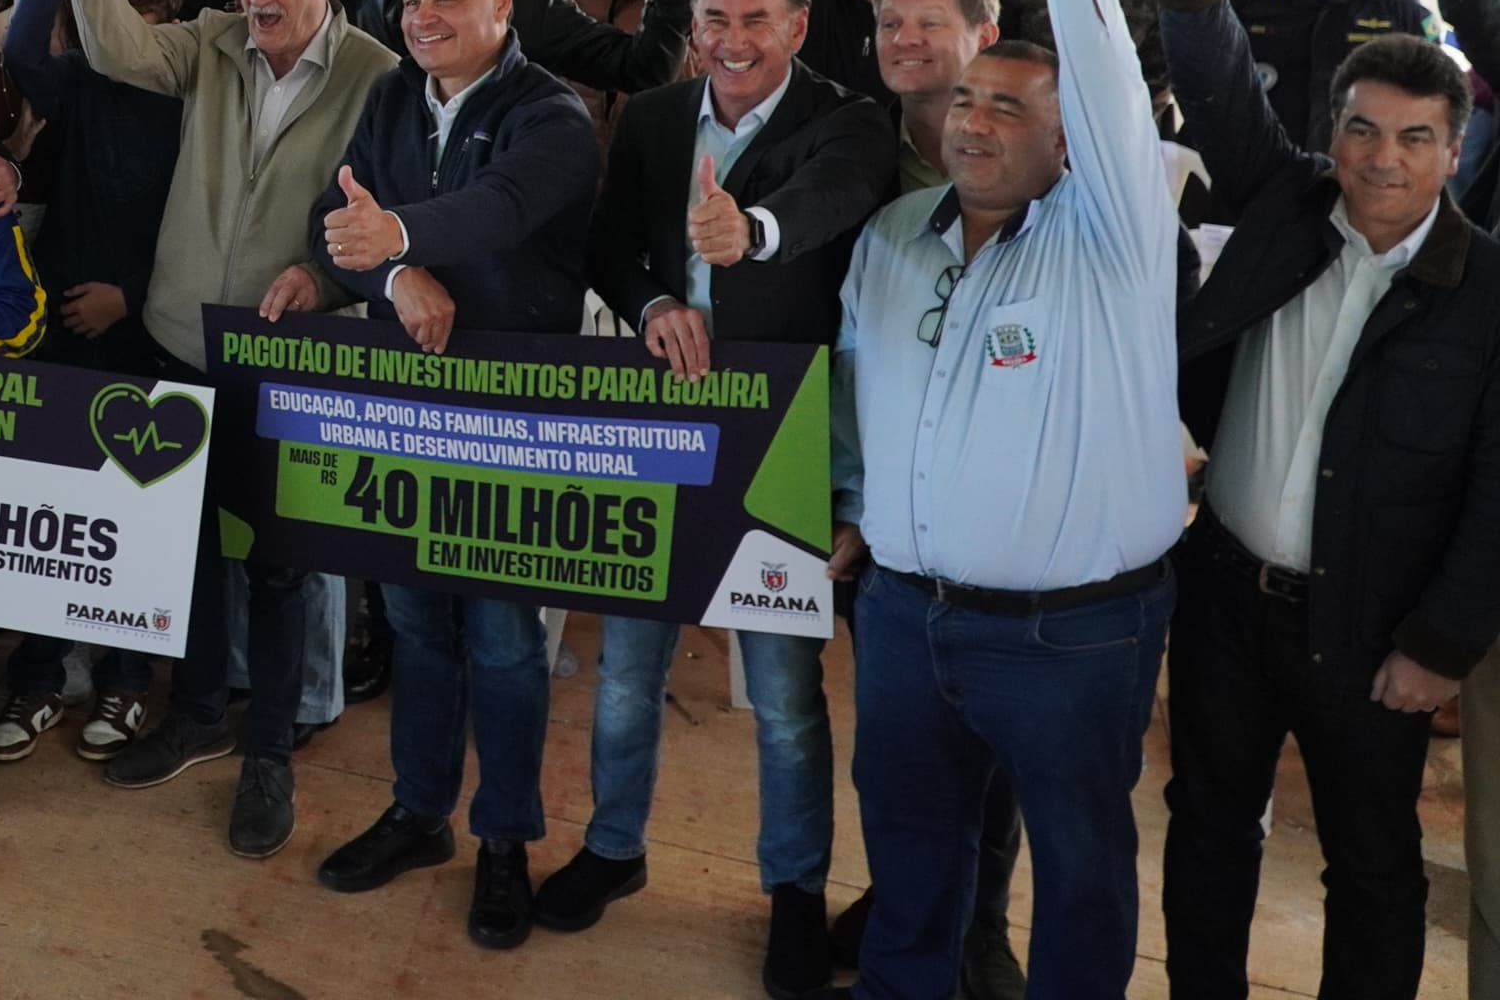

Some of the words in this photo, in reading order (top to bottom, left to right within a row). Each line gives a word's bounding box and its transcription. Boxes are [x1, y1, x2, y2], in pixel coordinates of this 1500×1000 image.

[223, 332, 331, 374] PACOTÃO
[336, 344, 364, 379] DE
[370, 348, 577, 399] INVESTIMENTOS
[582, 365, 657, 404] PARA
[662, 367, 770, 409] GUAÍRA
[269, 389, 362, 422] EDUCAÇÃO,
[364, 401, 416, 427] APOIO
[418, 407, 443, 431] ÀS
[445, 413, 534, 443] FAMÍLIAS,
[538, 421, 706, 452] INFRAESTRUTURA
[289, 448, 321, 466] MAIS
[323, 452, 339, 468] DE
[320, 422, 389, 450] URBANA
[391, 432, 401, 452] E
[404, 434, 572, 471] DESENVOLVIMENTO
[576, 451, 638, 476] RURAL
[343, 456, 419, 529] 40
[428, 476, 657, 559] MILHÕES
[428, 540, 462, 569] EM
[466, 545, 654, 593] INVESTIMENTOS
[66, 602, 148, 629] PARANÁ
[730, 592, 819, 613] PARANÁ
